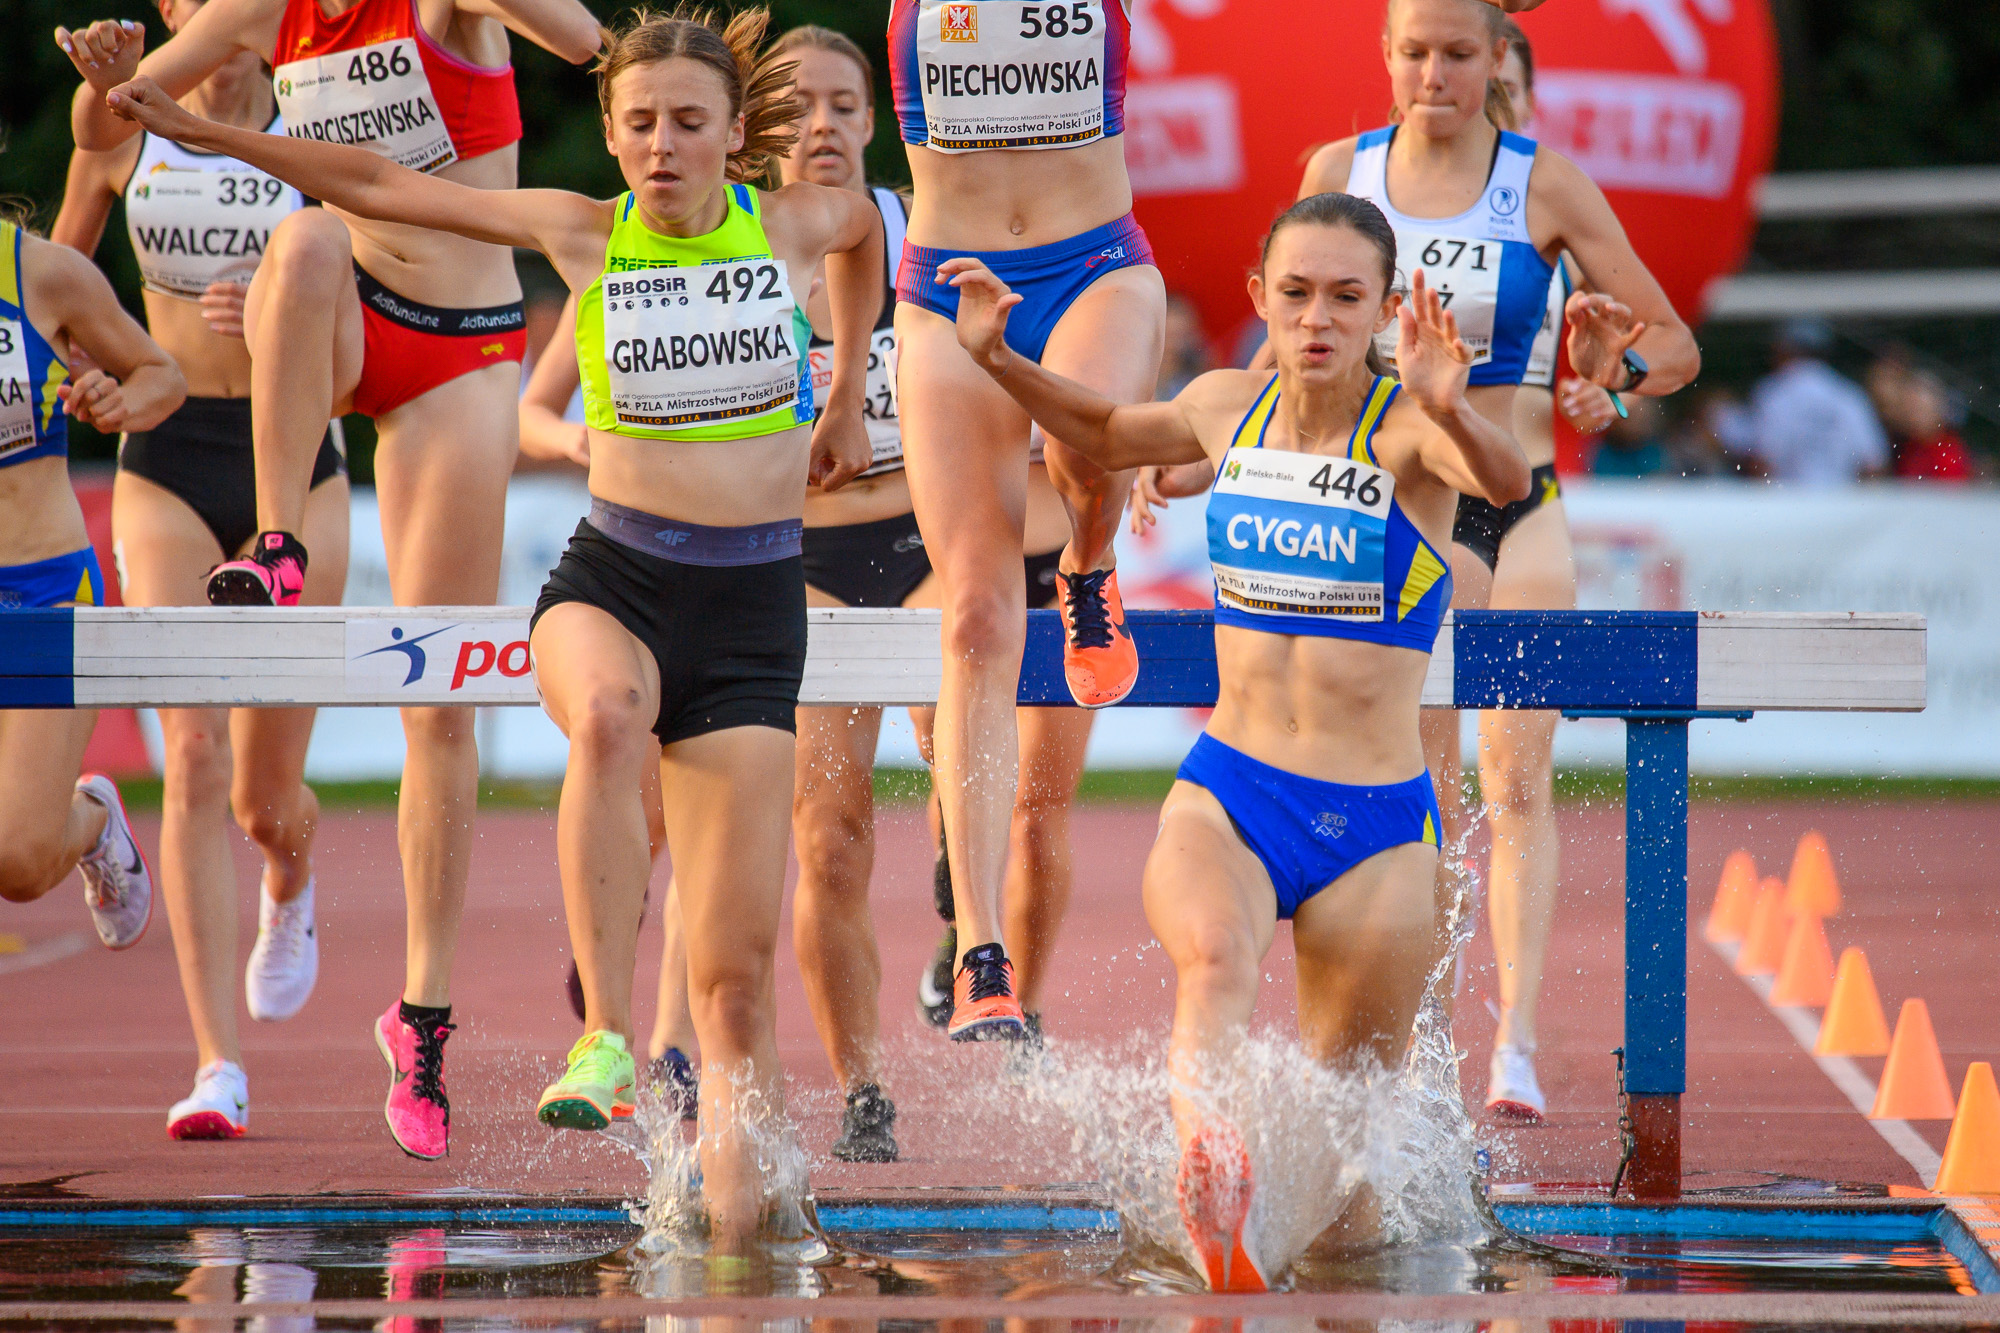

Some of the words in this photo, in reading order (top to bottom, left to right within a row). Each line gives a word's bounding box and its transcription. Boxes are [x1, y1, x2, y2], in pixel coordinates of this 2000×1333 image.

[1019, 2, 1093, 39] 585
[943, 31, 976, 41] PZLA
[347, 45, 411, 85] 486
[926, 57, 1099, 97] PIECHOWSKA
[928, 122, 941, 134] 54.
[944, 124, 972, 135] PZLA
[975, 122, 1044, 135] Mistrzostwa
[1048, 118, 1081, 131] Polski
[1084, 111, 1102, 126] U18
[941, 116, 985, 124] Ogólnopolska
[986, 115, 1019, 123] Olimpiada
[1020, 113, 1052, 121] Młodzieży
[1060, 111, 1079, 119] lekkiej
[430, 140, 449, 156] U18
[932, 137, 1008, 148] BIELSKO-BIAŁA
[1027, 128, 1099, 145] 15-17.07.2022
[218, 177, 282, 207] 339
[1421, 239, 1488, 272] 671
[608, 277, 687, 297] BBOSiR
[705, 264, 783, 304] 492
[612, 324, 792, 374] GRABOWSKA
[615, 401, 632, 411] 54.
[635, 401, 663, 412] PZLA
[667, 396, 737, 412] Mistrzostwa
[741, 387, 773, 402] Polski
[776, 379, 796, 394] U18
[631, 392, 676, 401] Ogólnopolska
[676, 388, 711, 399] Olimpiada
[712, 384, 744, 394] Młodzieży
[752, 380, 772, 390] lekkiej
[620, 413, 701, 425] BIELSKO-BIAŁA
[720, 394, 791, 419] 15-17.07.2022
[1246, 468, 1294, 482] Bielsko-Biała
[1309, 463, 1381, 507] 446
[654, 529, 692, 547] 4F
[1227, 513, 1357, 564] CYGAN
[1229, 577, 1246, 590] PZLA
[1249, 582, 1316, 601] Mistrzostwa
[1319, 591, 1355, 601] Polski
[1358, 593, 1381, 602] U18
[1297, 605, 1378, 615] 15-17.07.2022
